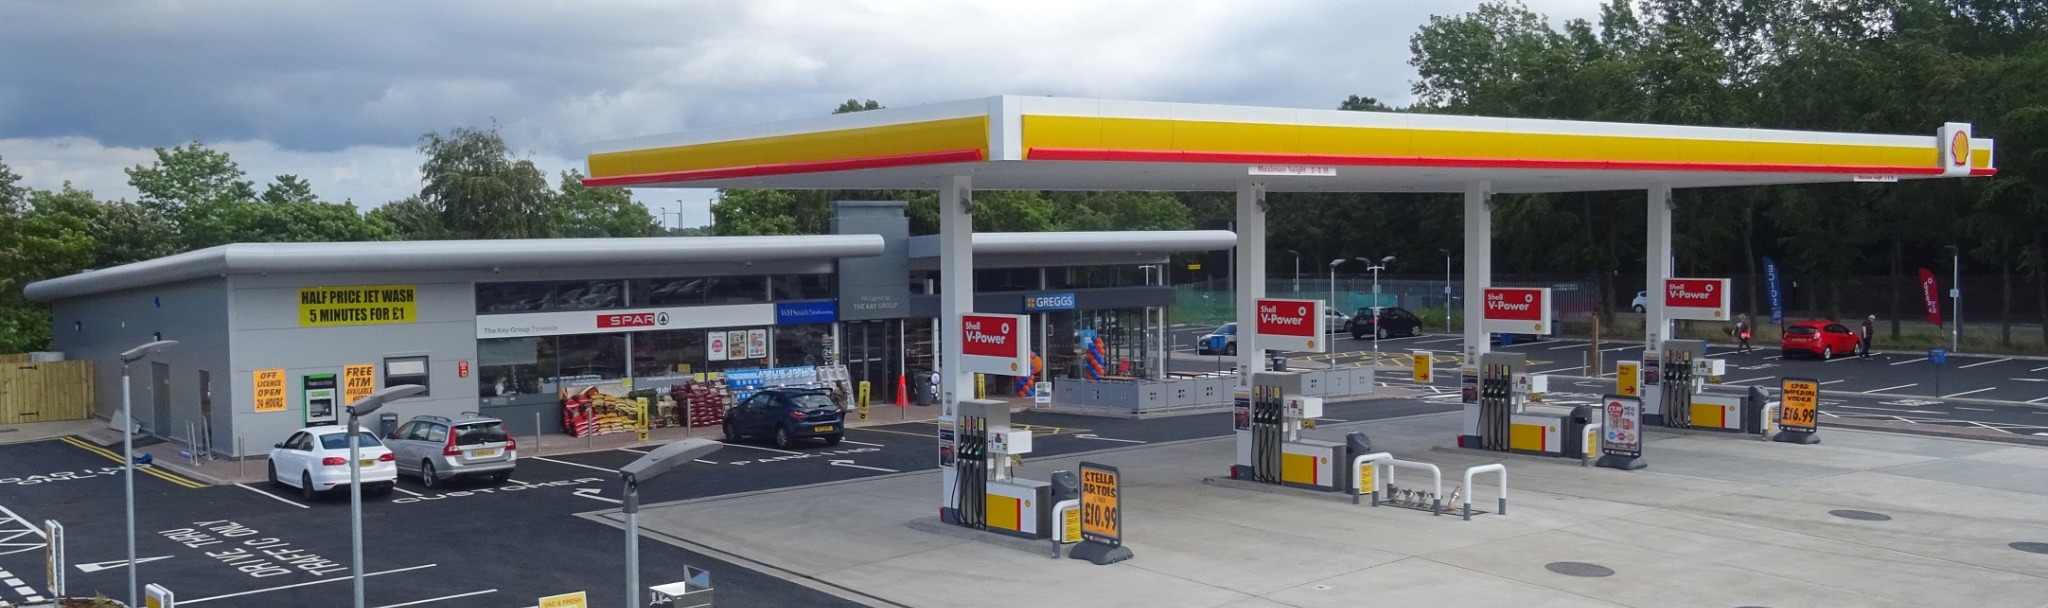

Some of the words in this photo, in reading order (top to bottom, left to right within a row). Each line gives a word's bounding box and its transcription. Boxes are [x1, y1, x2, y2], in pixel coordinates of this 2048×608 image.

[301, 290, 328, 305] HALF
[330, 290, 361, 304] PRICE
[363, 289, 379, 303] JET
[381, 289, 414, 303] WASH
[1487, 293, 1504, 301] Shell
[1669, 290, 1710, 299] V-Power
[1036, 296, 1073, 307] GREGGS
[1487, 300, 1530, 311] V-Power
[309, 309, 317, 323] 5
[320, 307, 367, 322] MINUTES
[370, 307, 390, 321] FOR
[392, 306, 405, 320] £1
[1260, 305, 1277, 313] Shell
[610, 314, 655, 326] SPAR
[1261, 313, 1303, 325] V-Power
[497, 327, 509, 335] Kay
[509, 326, 531, 334] Group
[965, 321, 981, 330] Shell
[966, 330, 1005, 344] V-Power
[260, 371, 278, 380] OFF
[346, 366, 373, 377] FREE
[256, 379, 282, 388] LICENCE
[348, 377, 371, 388] ATM
[257, 388, 282, 397] OPEN
[346, 387, 373, 396] AVAILABLE
[265, 397, 284, 408] HOURS
[1783, 407, 1815, 422] £16.99
[1084, 472, 1114, 485] STELLA
[1083, 483, 1116, 498] ARTOIS
[1085, 502, 1117, 531] £10.99
[192, 518, 260, 538] ONLY
[157, 527, 224, 549] THRU
[243, 536, 349, 577] TRAFFIC
[204, 547, 293, 578] DRIVE
[562, 597, 582, 606] FRESH
